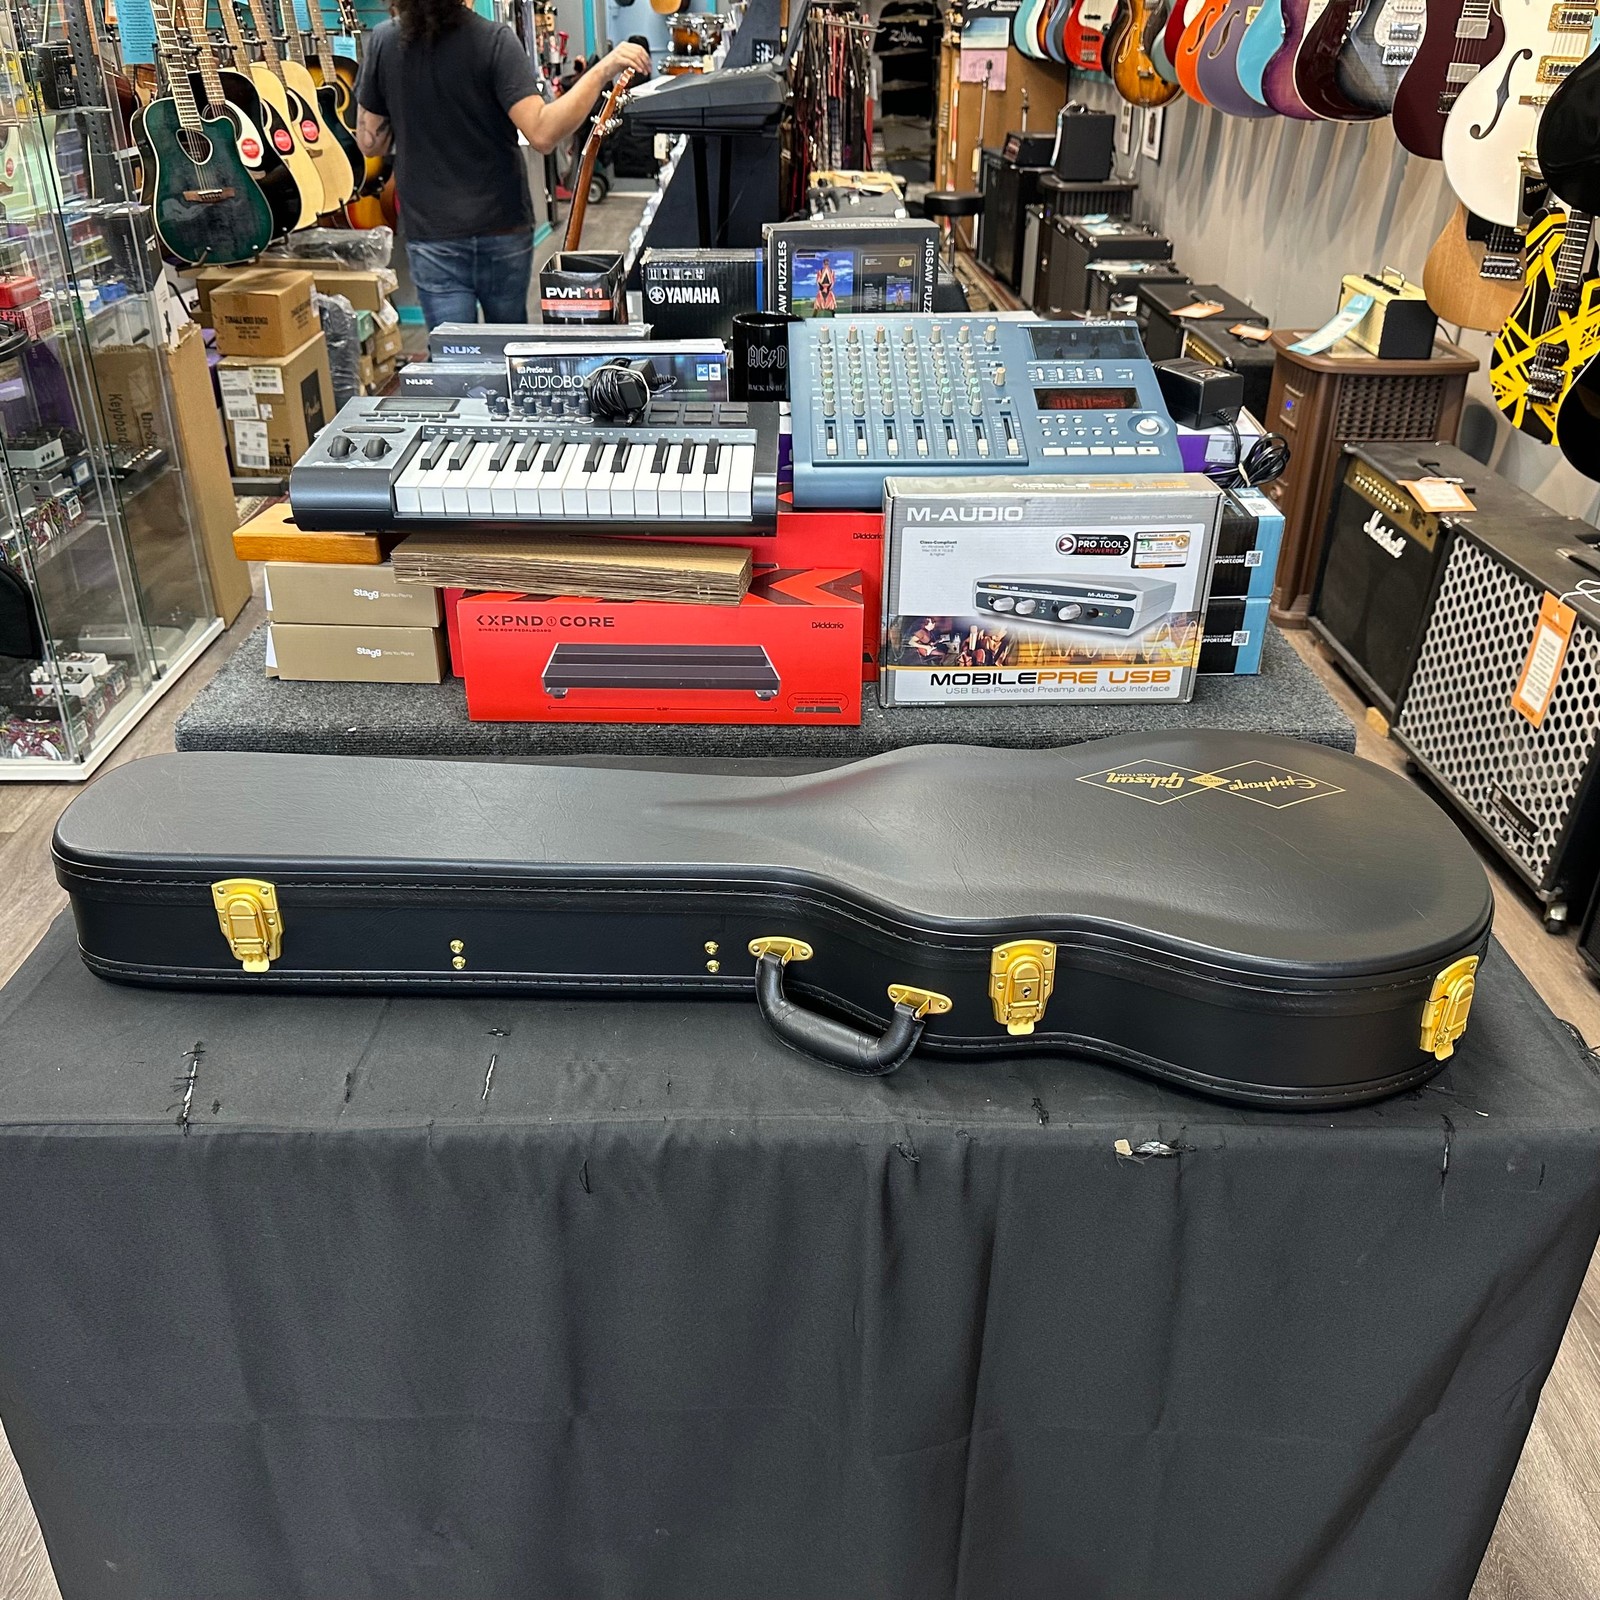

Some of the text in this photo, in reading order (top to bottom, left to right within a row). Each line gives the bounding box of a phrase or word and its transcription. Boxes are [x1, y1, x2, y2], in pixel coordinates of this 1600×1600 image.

[777, 240, 788, 292] PUZZLES
[923, 238, 934, 314] JIGSAW PUZZ
[584, 287, 603, 298] 11
[666, 287, 720, 304] YAMAHA
[442, 345, 482, 355] NUX
[525, 366, 553, 374] PreSonus
[698, 366, 708, 374] PC
[405, 378, 434, 386] NUX
[519, 375, 586, 389] AUDIOBO
[108, 393, 131, 443] Keyboard
[906, 506, 1024, 522] M-AUDIO
[1363, 509, 1407, 559] Marshall
[1077, 540, 1129, 548] PRO TOOLS
[353, 588, 379, 600] Stagg
[559, 616, 615, 628] CORE
[356, 647, 382, 658] Stagg
[930, 670, 1172, 686] MOBILEPRE USB
[945, 687, 968, 695] USB
[971, 686, 1035, 695] Bus-Powered
[1037, 686, 1075, 695] Preamp
[1099, 685, 1126, 693] Audio
[1106, 772, 1186, 789] Gibson
[1229, 775, 1319, 792] Epiphone
